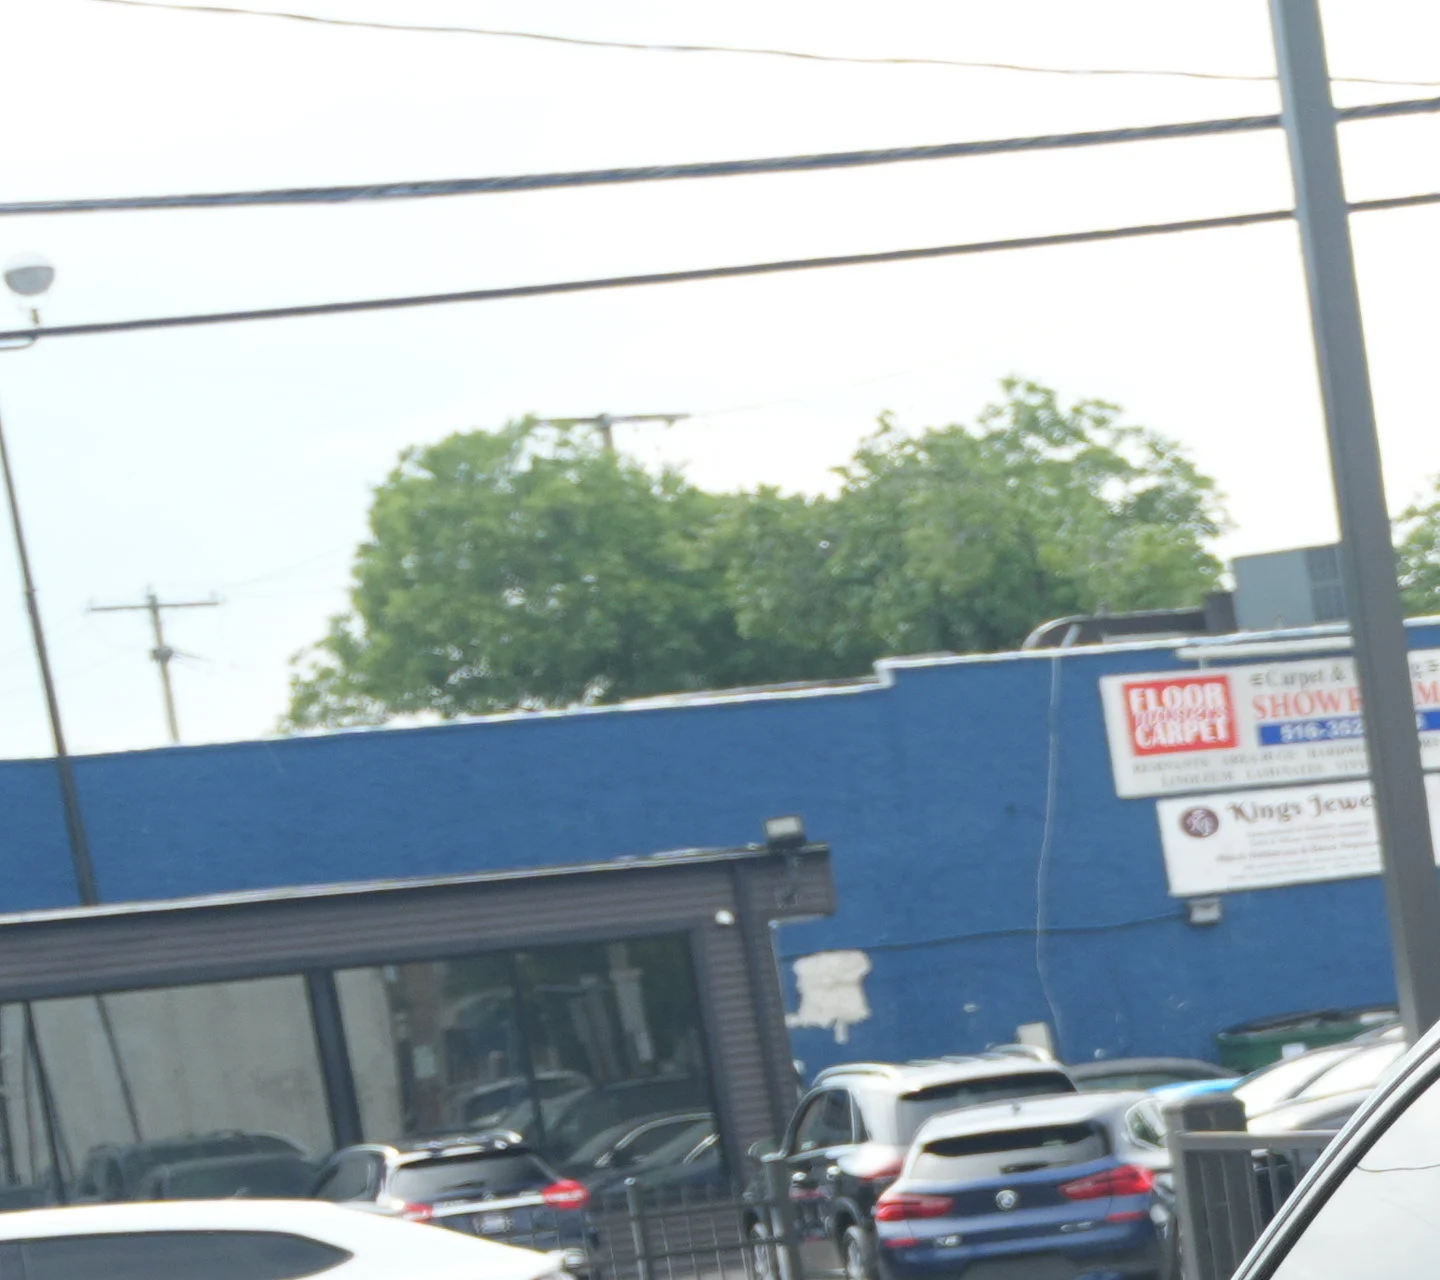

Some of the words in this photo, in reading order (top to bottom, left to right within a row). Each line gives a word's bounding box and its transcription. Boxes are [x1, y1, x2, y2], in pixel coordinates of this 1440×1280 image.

[1266, 669, 1324, 687] Carpet
[1331, 667, 1346, 682] &
[1130, 682, 1225, 714] FLOOR
[1135, 717, 1229, 749] CARPET
[1226, 799, 1302, 822] Kings
